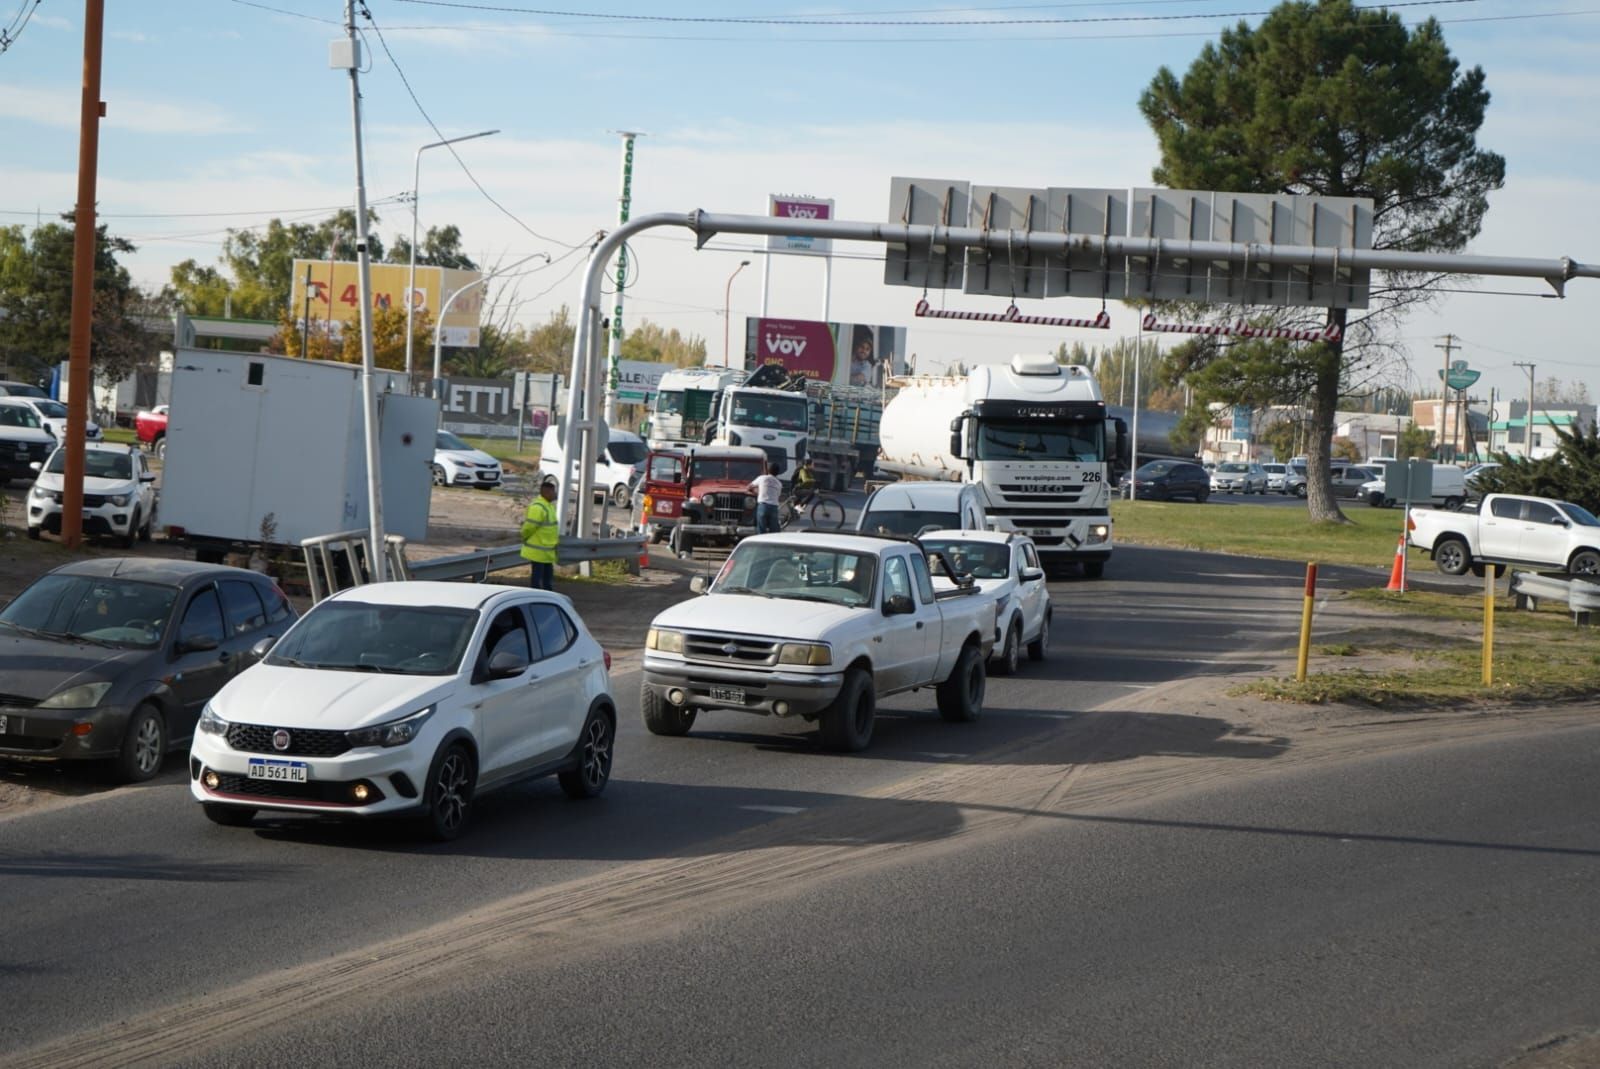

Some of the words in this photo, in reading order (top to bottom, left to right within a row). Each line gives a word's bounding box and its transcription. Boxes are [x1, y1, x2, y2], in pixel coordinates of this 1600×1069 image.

[442, 384, 510, 415] ETTI
[1081, 471, 1101, 483] 226
[251, 765, 265, 777] AD
[267, 767, 287, 779] 561
[291, 768, 305, 781] HL
